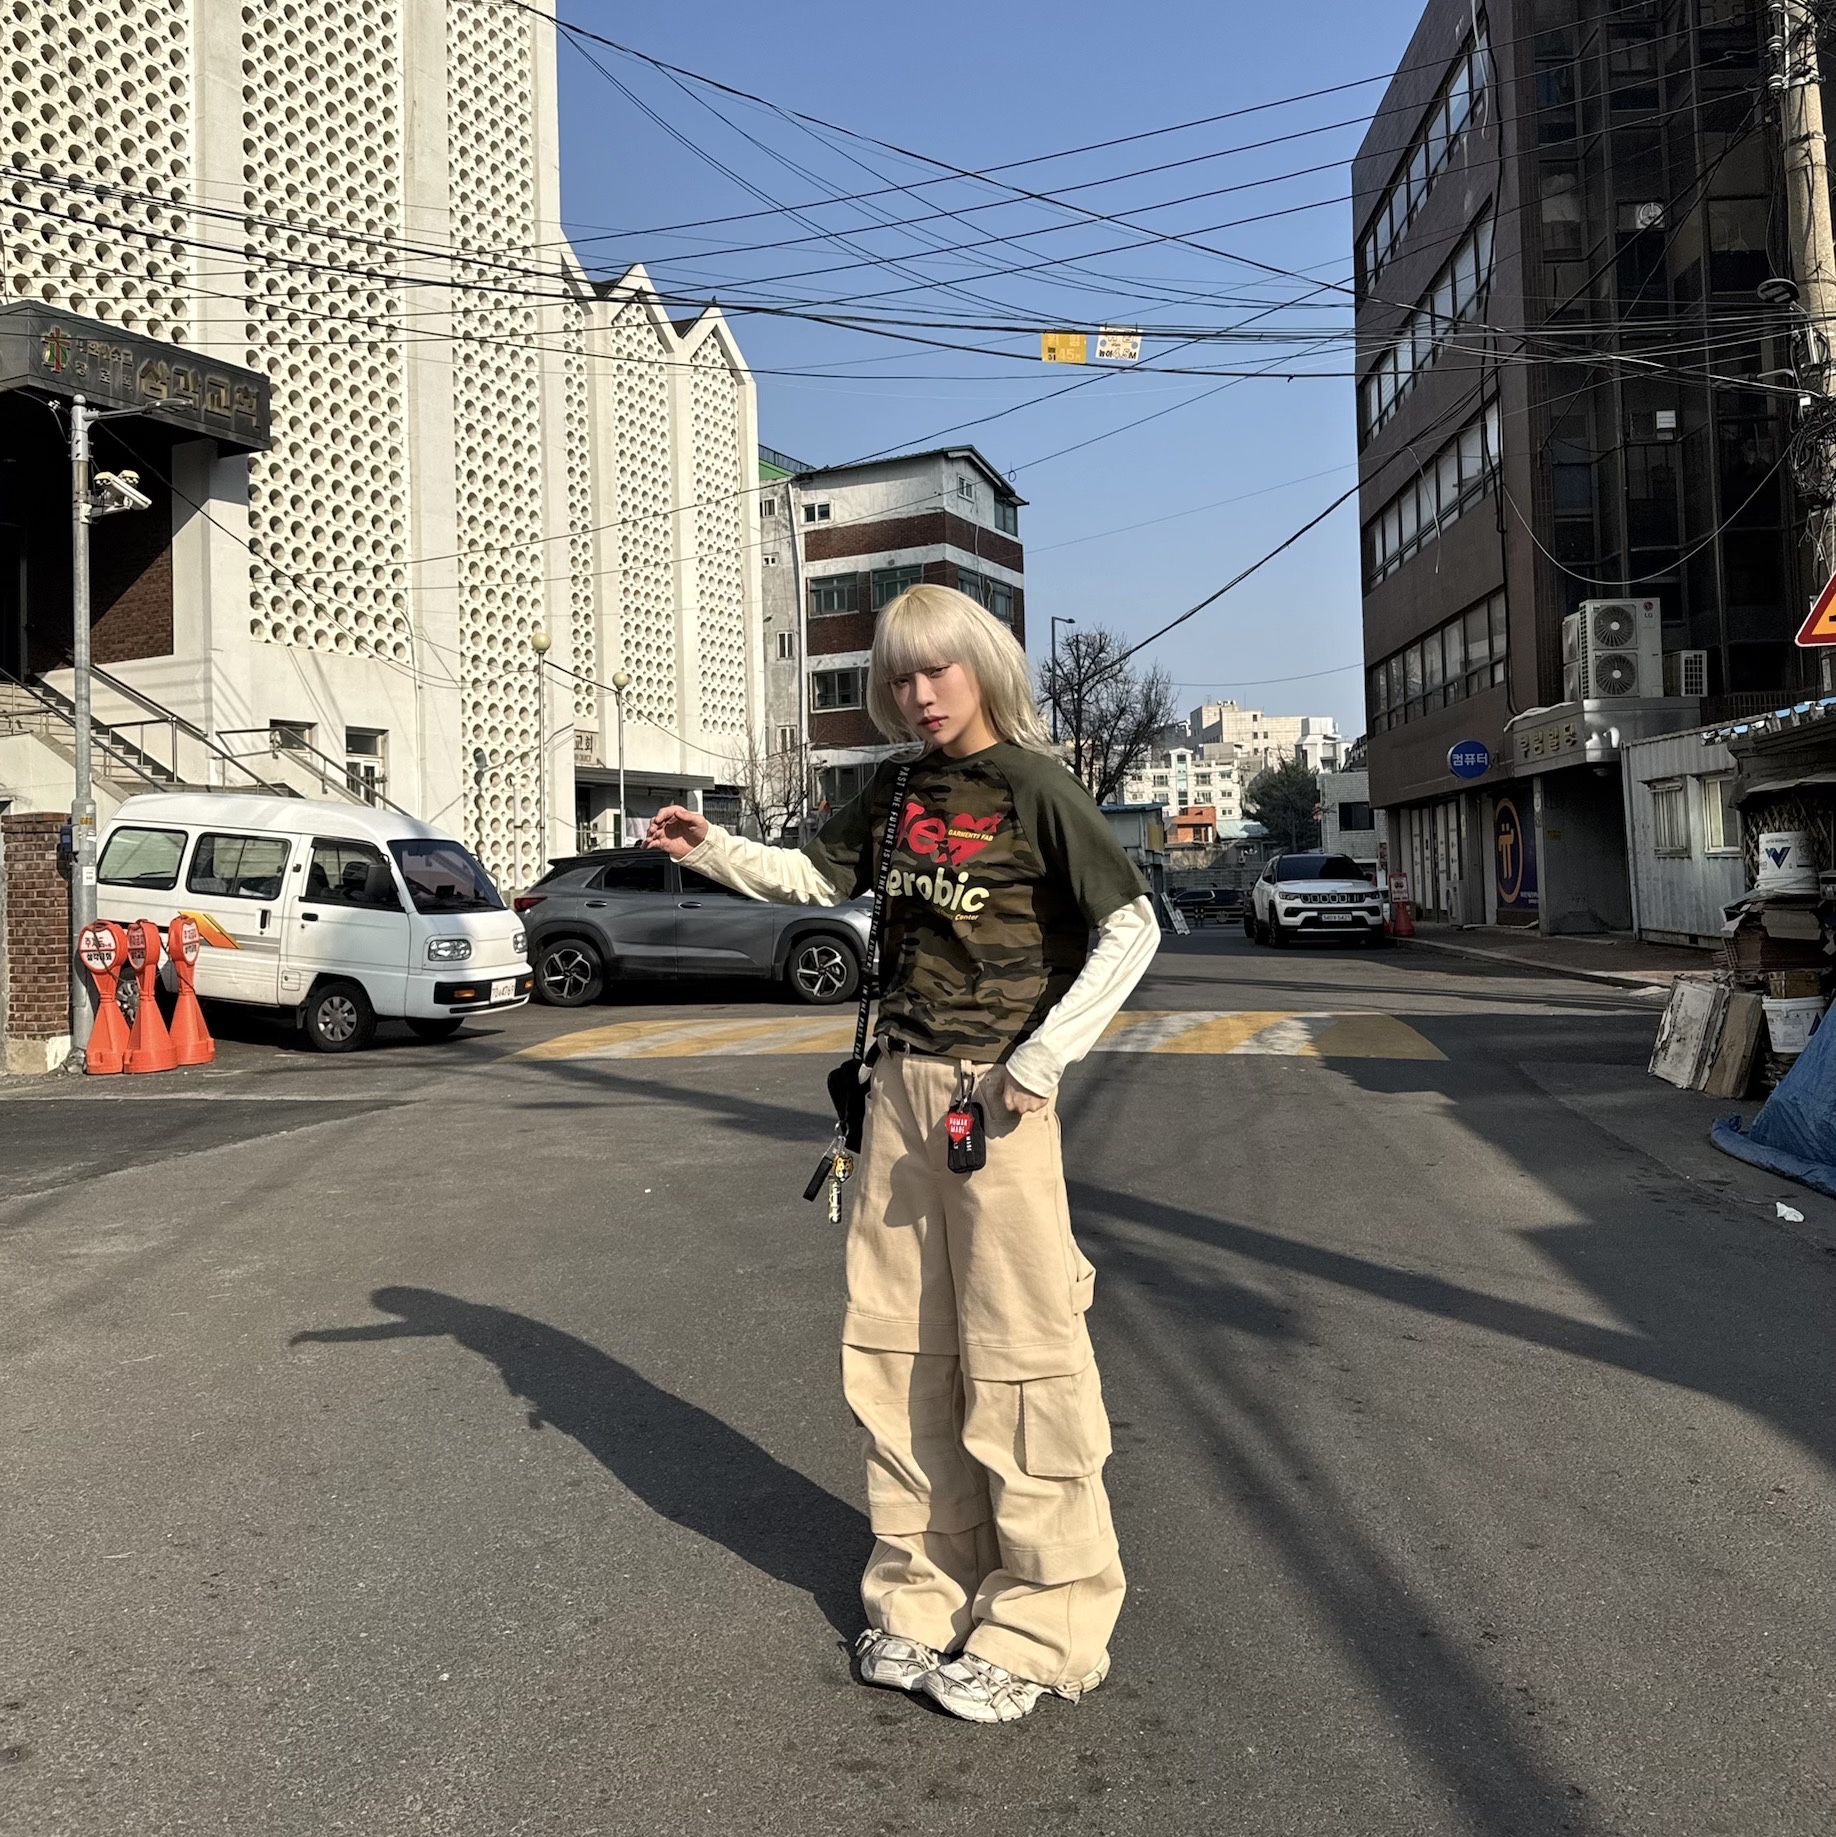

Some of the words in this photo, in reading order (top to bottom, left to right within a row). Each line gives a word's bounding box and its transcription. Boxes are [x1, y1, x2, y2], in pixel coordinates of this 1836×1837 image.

[138, 359, 261, 428] 삼각교회
[1452, 752, 1488, 766] 컴퓨터
[897, 766, 910, 787] PAST
[892, 791, 903, 808] THE
[885, 810, 899, 846] FUTURE
[948, 829, 981, 839] GARMENTS
[980, 833, 994, 842] FAB
[883, 848, 891, 859] IS
[881, 861, 889, 872] IN
[877, 874, 887, 892] THE
[874, 893, 884, 916] PAST
[954, 913, 980, 921] Center
[871, 920, 879, 937] THE
[857, 1017, 865, 1038] PAST
[950, 1125, 965, 1134] MADE
